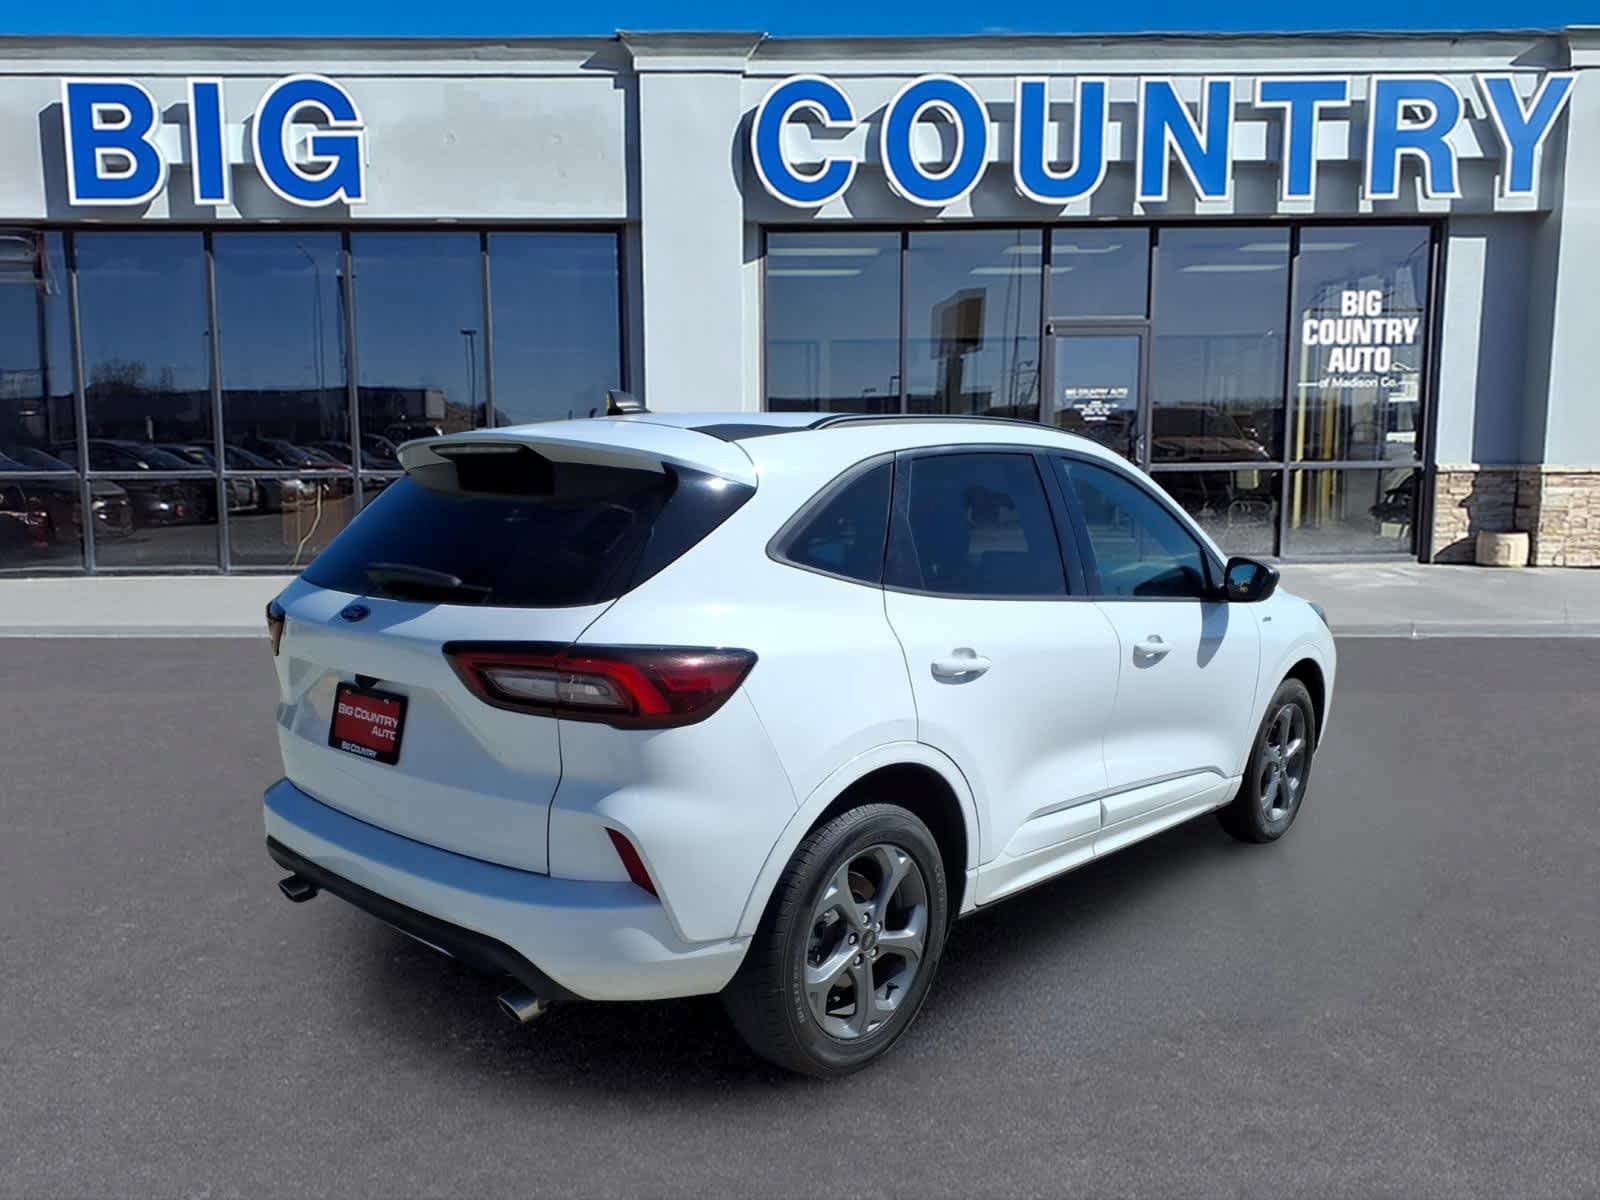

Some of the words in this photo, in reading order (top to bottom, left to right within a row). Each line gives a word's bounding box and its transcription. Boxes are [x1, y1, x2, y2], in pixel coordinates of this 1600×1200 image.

[61, 73, 366, 207] BIG
[751, 72, 1576, 209] COUNTRY
[1341, 290, 1383, 317] BIG
[1302, 317, 1420, 345] COUNTRY
[1328, 346, 1392, 373] AUTO
[338, 703, 354, 717] BIG
[354, 706, 399, 728] COUNTRY
[371, 725, 397, 741] AUTO
